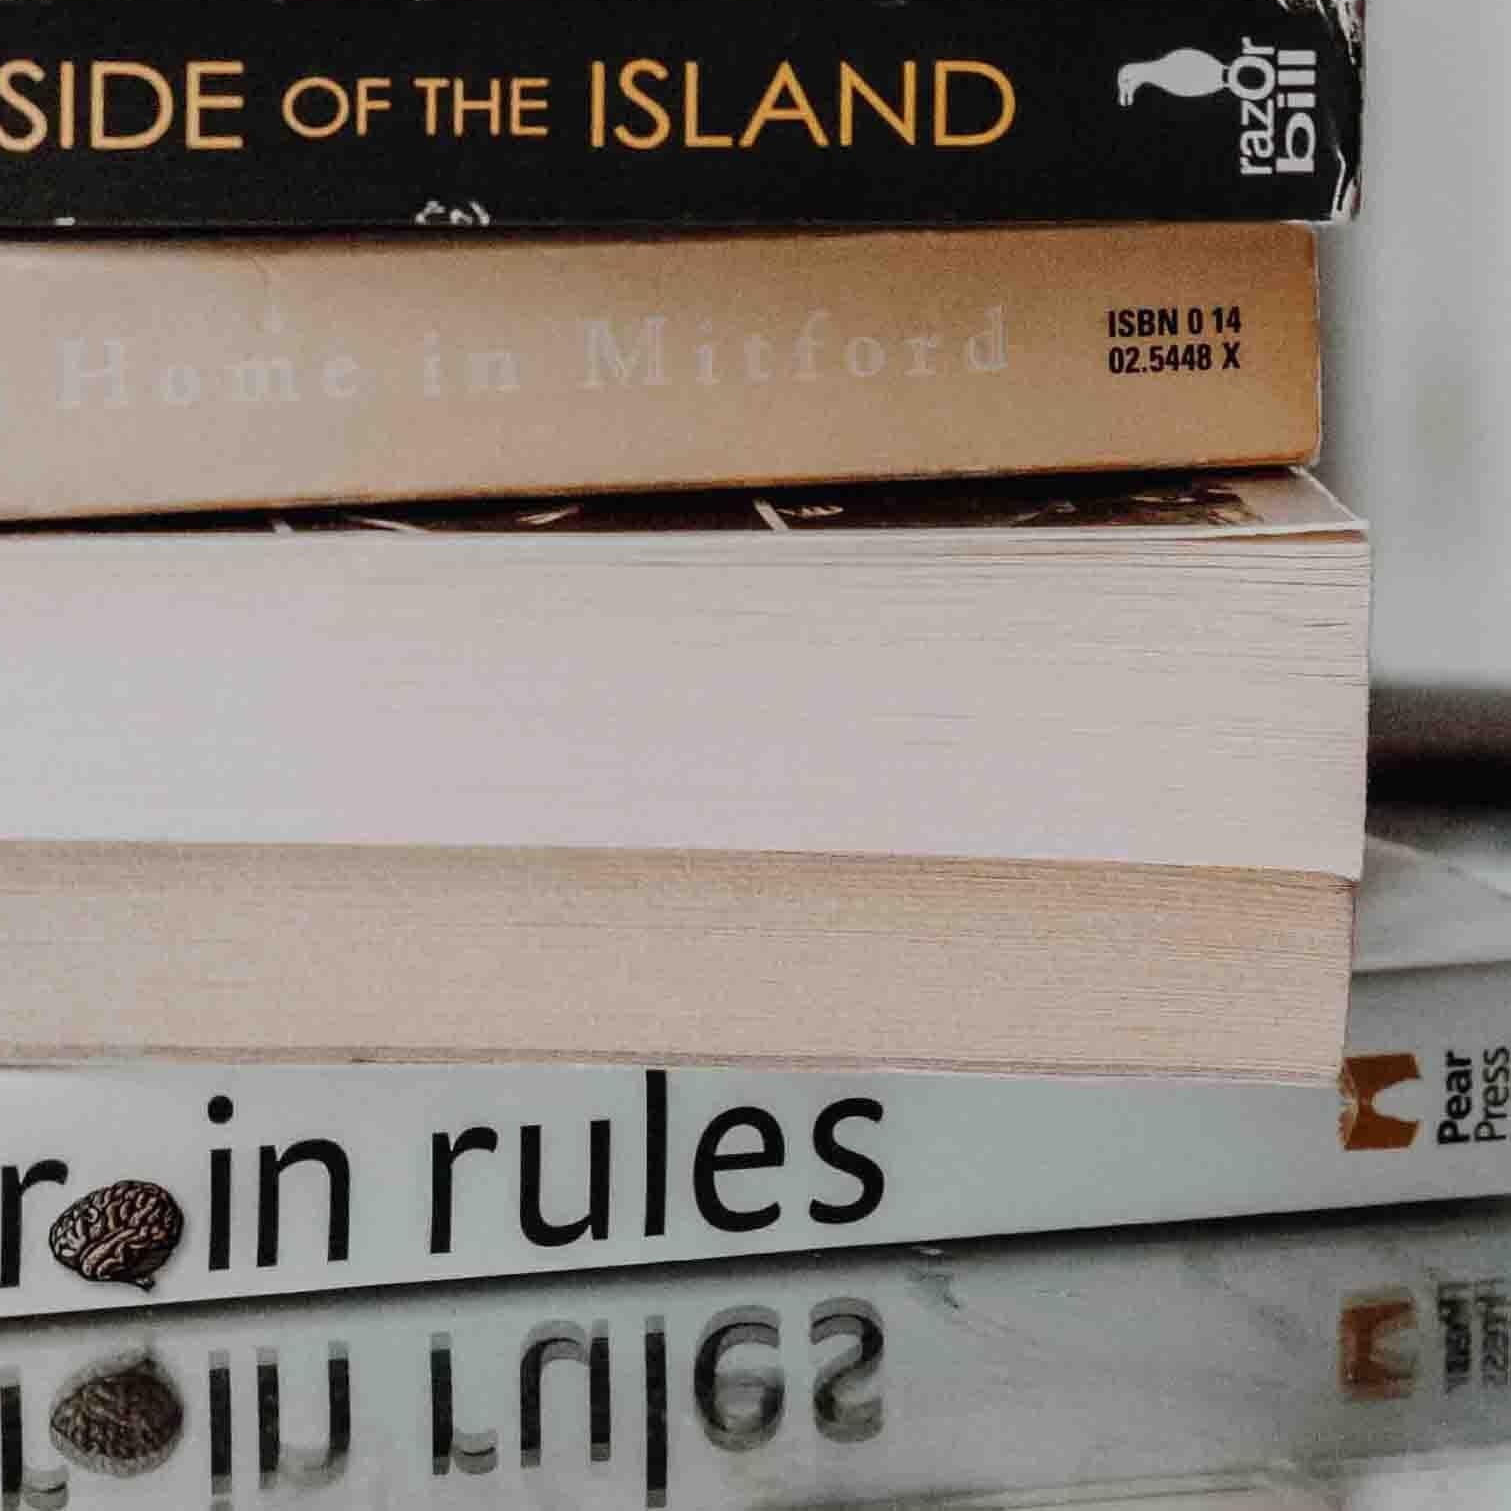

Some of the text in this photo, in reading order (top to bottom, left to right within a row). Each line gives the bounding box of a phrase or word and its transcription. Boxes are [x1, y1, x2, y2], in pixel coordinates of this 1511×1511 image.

[282, 76, 391, 138] OF
[413, 77, 549, 137] THE
[590, 58, 1016, 149] ISLAND
[1275, 50, 1317, 173] bill
[55, 337, 361, 413] Home
[422, 329, 522, 401] in
[583, 305, 1009, 387] Mitford
[1107, 306, 1242, 338] ISBN 0 14
[1108, 341, 1242, 375] 02.5448 X
[1437, 1050, 1472, 1146] Pear
[1474, 1045, 1510, 1143] Press
[429, 1069, 886, 1254] rules
